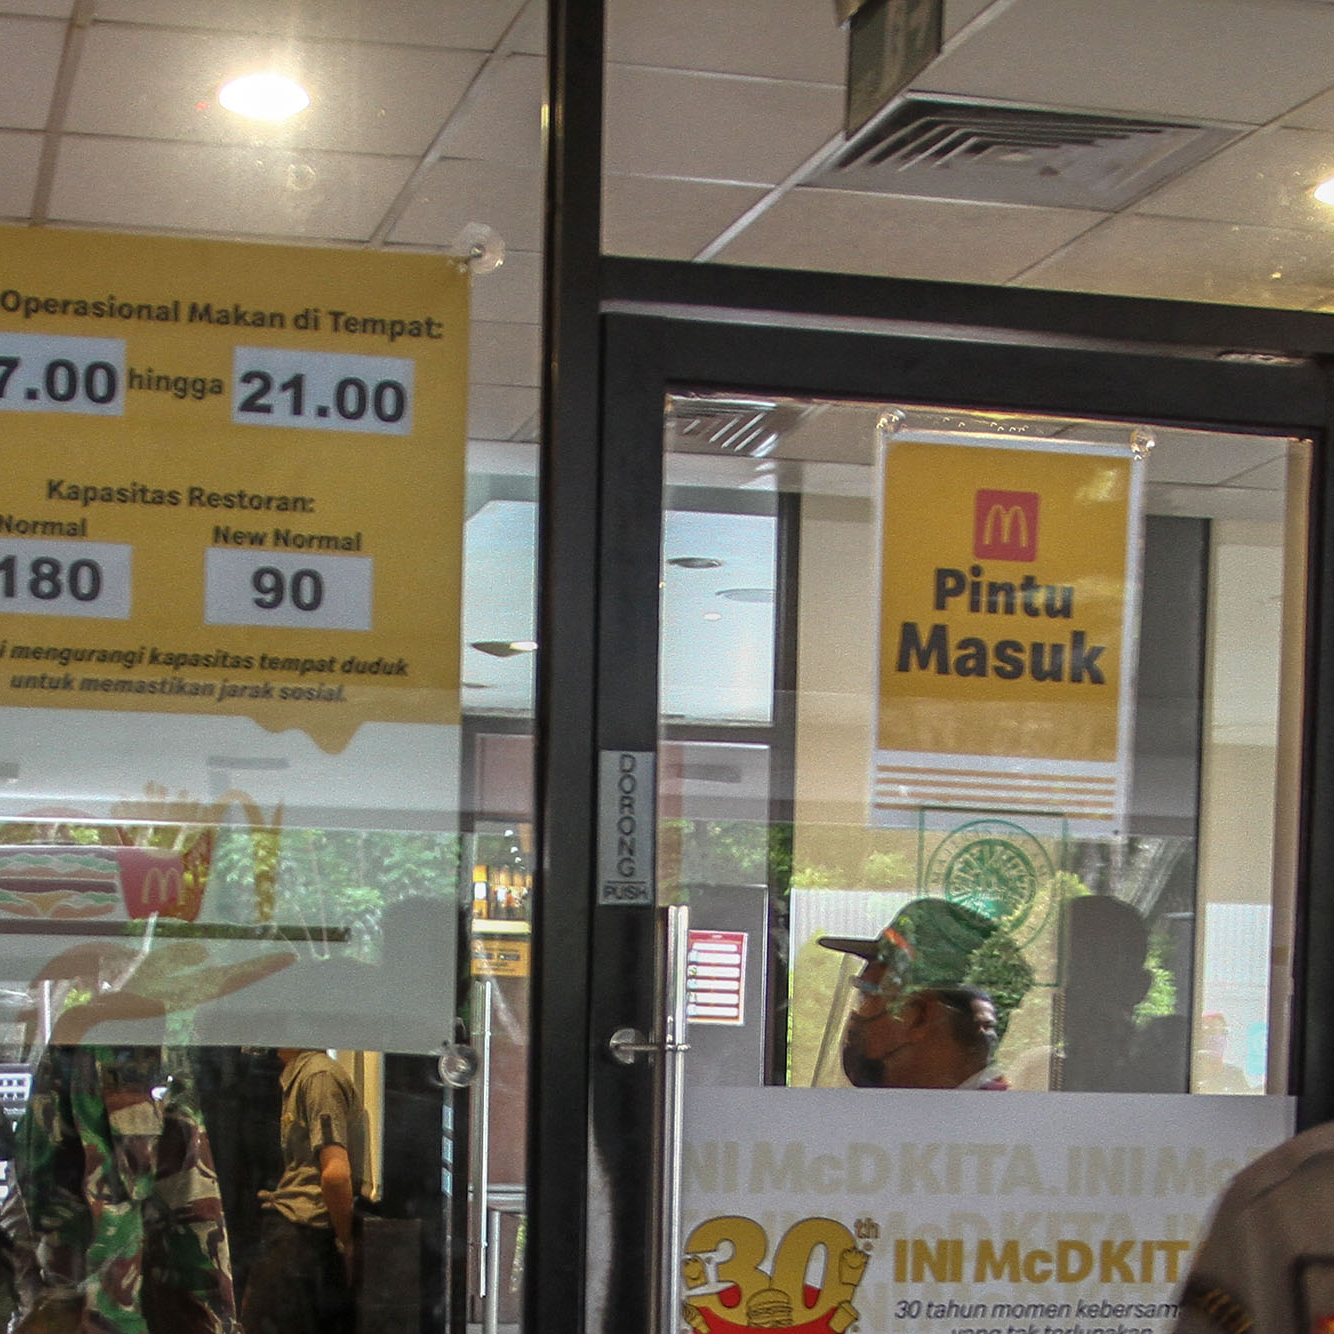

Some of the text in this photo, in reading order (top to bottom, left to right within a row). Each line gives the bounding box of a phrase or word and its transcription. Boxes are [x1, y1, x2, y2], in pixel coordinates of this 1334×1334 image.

[0, 289, 180, 322] Operasional
[188, 302, 286, 329] Makan
[293, 308, 320, 331] di
[329, 310, 444, 342] Tempat:
[129, 367, 223, 399] hingga
[239, 370, 407, 423] 21.00
[47, 479, 315, 513] Kapasitas Restoran:
[213, 525, 363, 551] New Normal
[252, 566, 324, 611] 90
[934, 564, 1074, 619] Pintu
[10, 645, 146, 668] mengurangi
[149, 647, 255, 670] kapasitas
[260, 653, 336, 676] tempat
[341, 655, 409, 676] duduk
[896, 621, 1107, 685] Masuk
[10, 672, 348, 702] untuk memastikan jarak sosial.
[616, 753, 637, 878] DORONG
[602, 884, 648, 900] PUSH
[894, 1239, 964, 1283] INI
[1100, 1239, 1192, 1284] KIT
[895, 1299, 1180, 1320] 30 tahun momen kebersam
